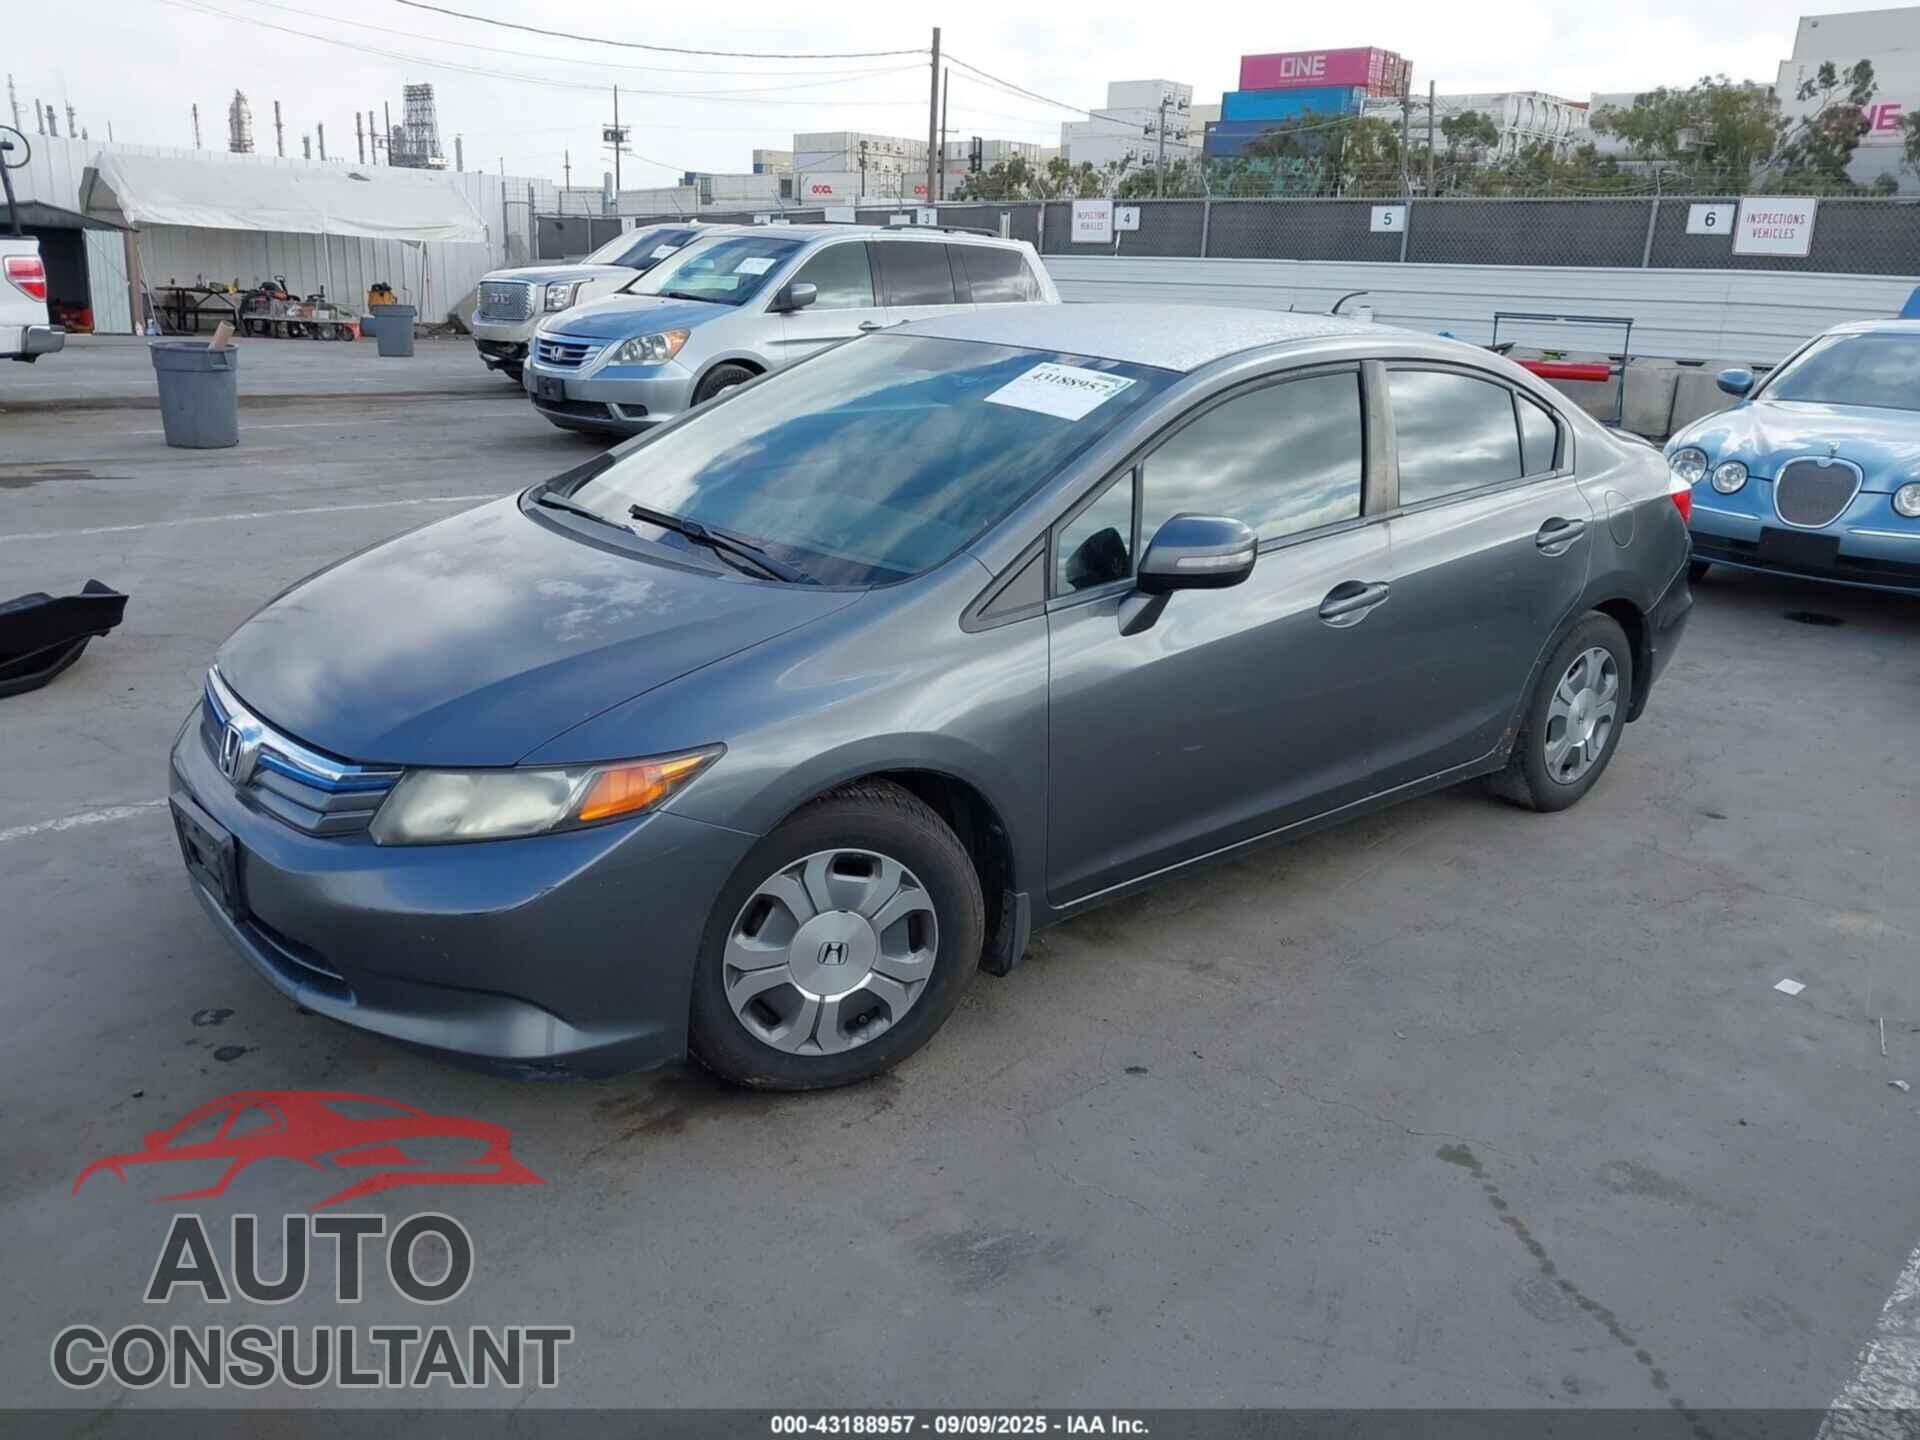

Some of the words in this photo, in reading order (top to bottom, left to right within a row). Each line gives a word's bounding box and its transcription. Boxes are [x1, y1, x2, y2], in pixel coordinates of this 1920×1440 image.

[1280, 55, 1326, 77] ONE
[924, 213, 931, 225] 3
[1123, 213, 1131, 225] 4
[1383, 212, 1392, 226] 5
[1704, 211, 1716, 227] 6
[1746, 212, 1807, 225] INSPECTIONS
[1752, 227, 1796, 239] VEHICLES
